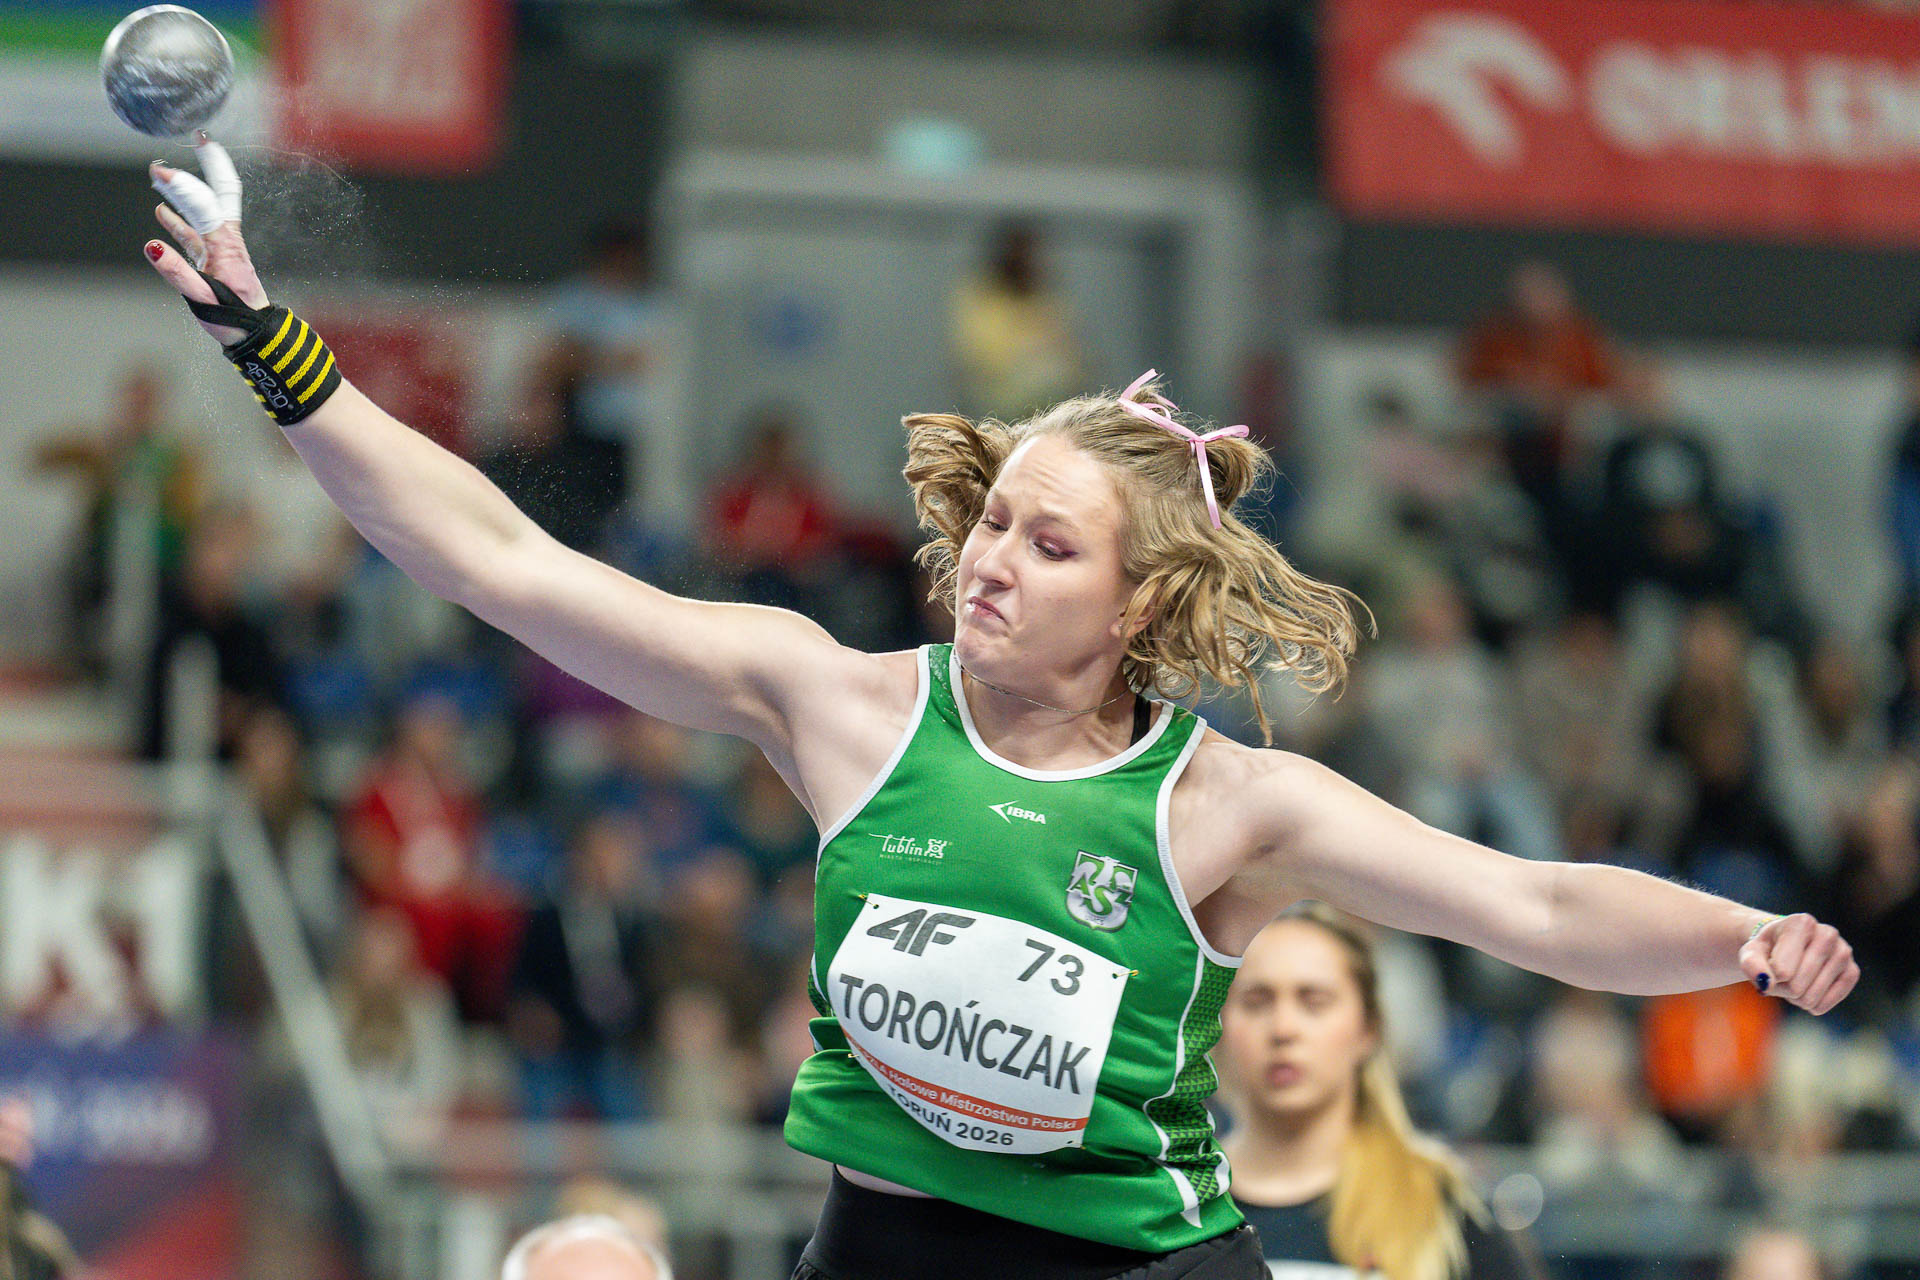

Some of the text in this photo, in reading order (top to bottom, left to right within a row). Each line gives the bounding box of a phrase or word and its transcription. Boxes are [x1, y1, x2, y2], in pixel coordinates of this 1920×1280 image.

[865, 908, 977, 957] 4F
[1016, 938, 1084, 996] 73
[838, 973, 1092, 1095] TOROŃCZAK
[887, 1083, 1014, 1146] TORUŃ 2026
[888, 1070, 938, 1100] Halowe
[939, 1091, 1028, 1126] Mistrzostwa
[1031, 1116, 1077, 1130] Polski
